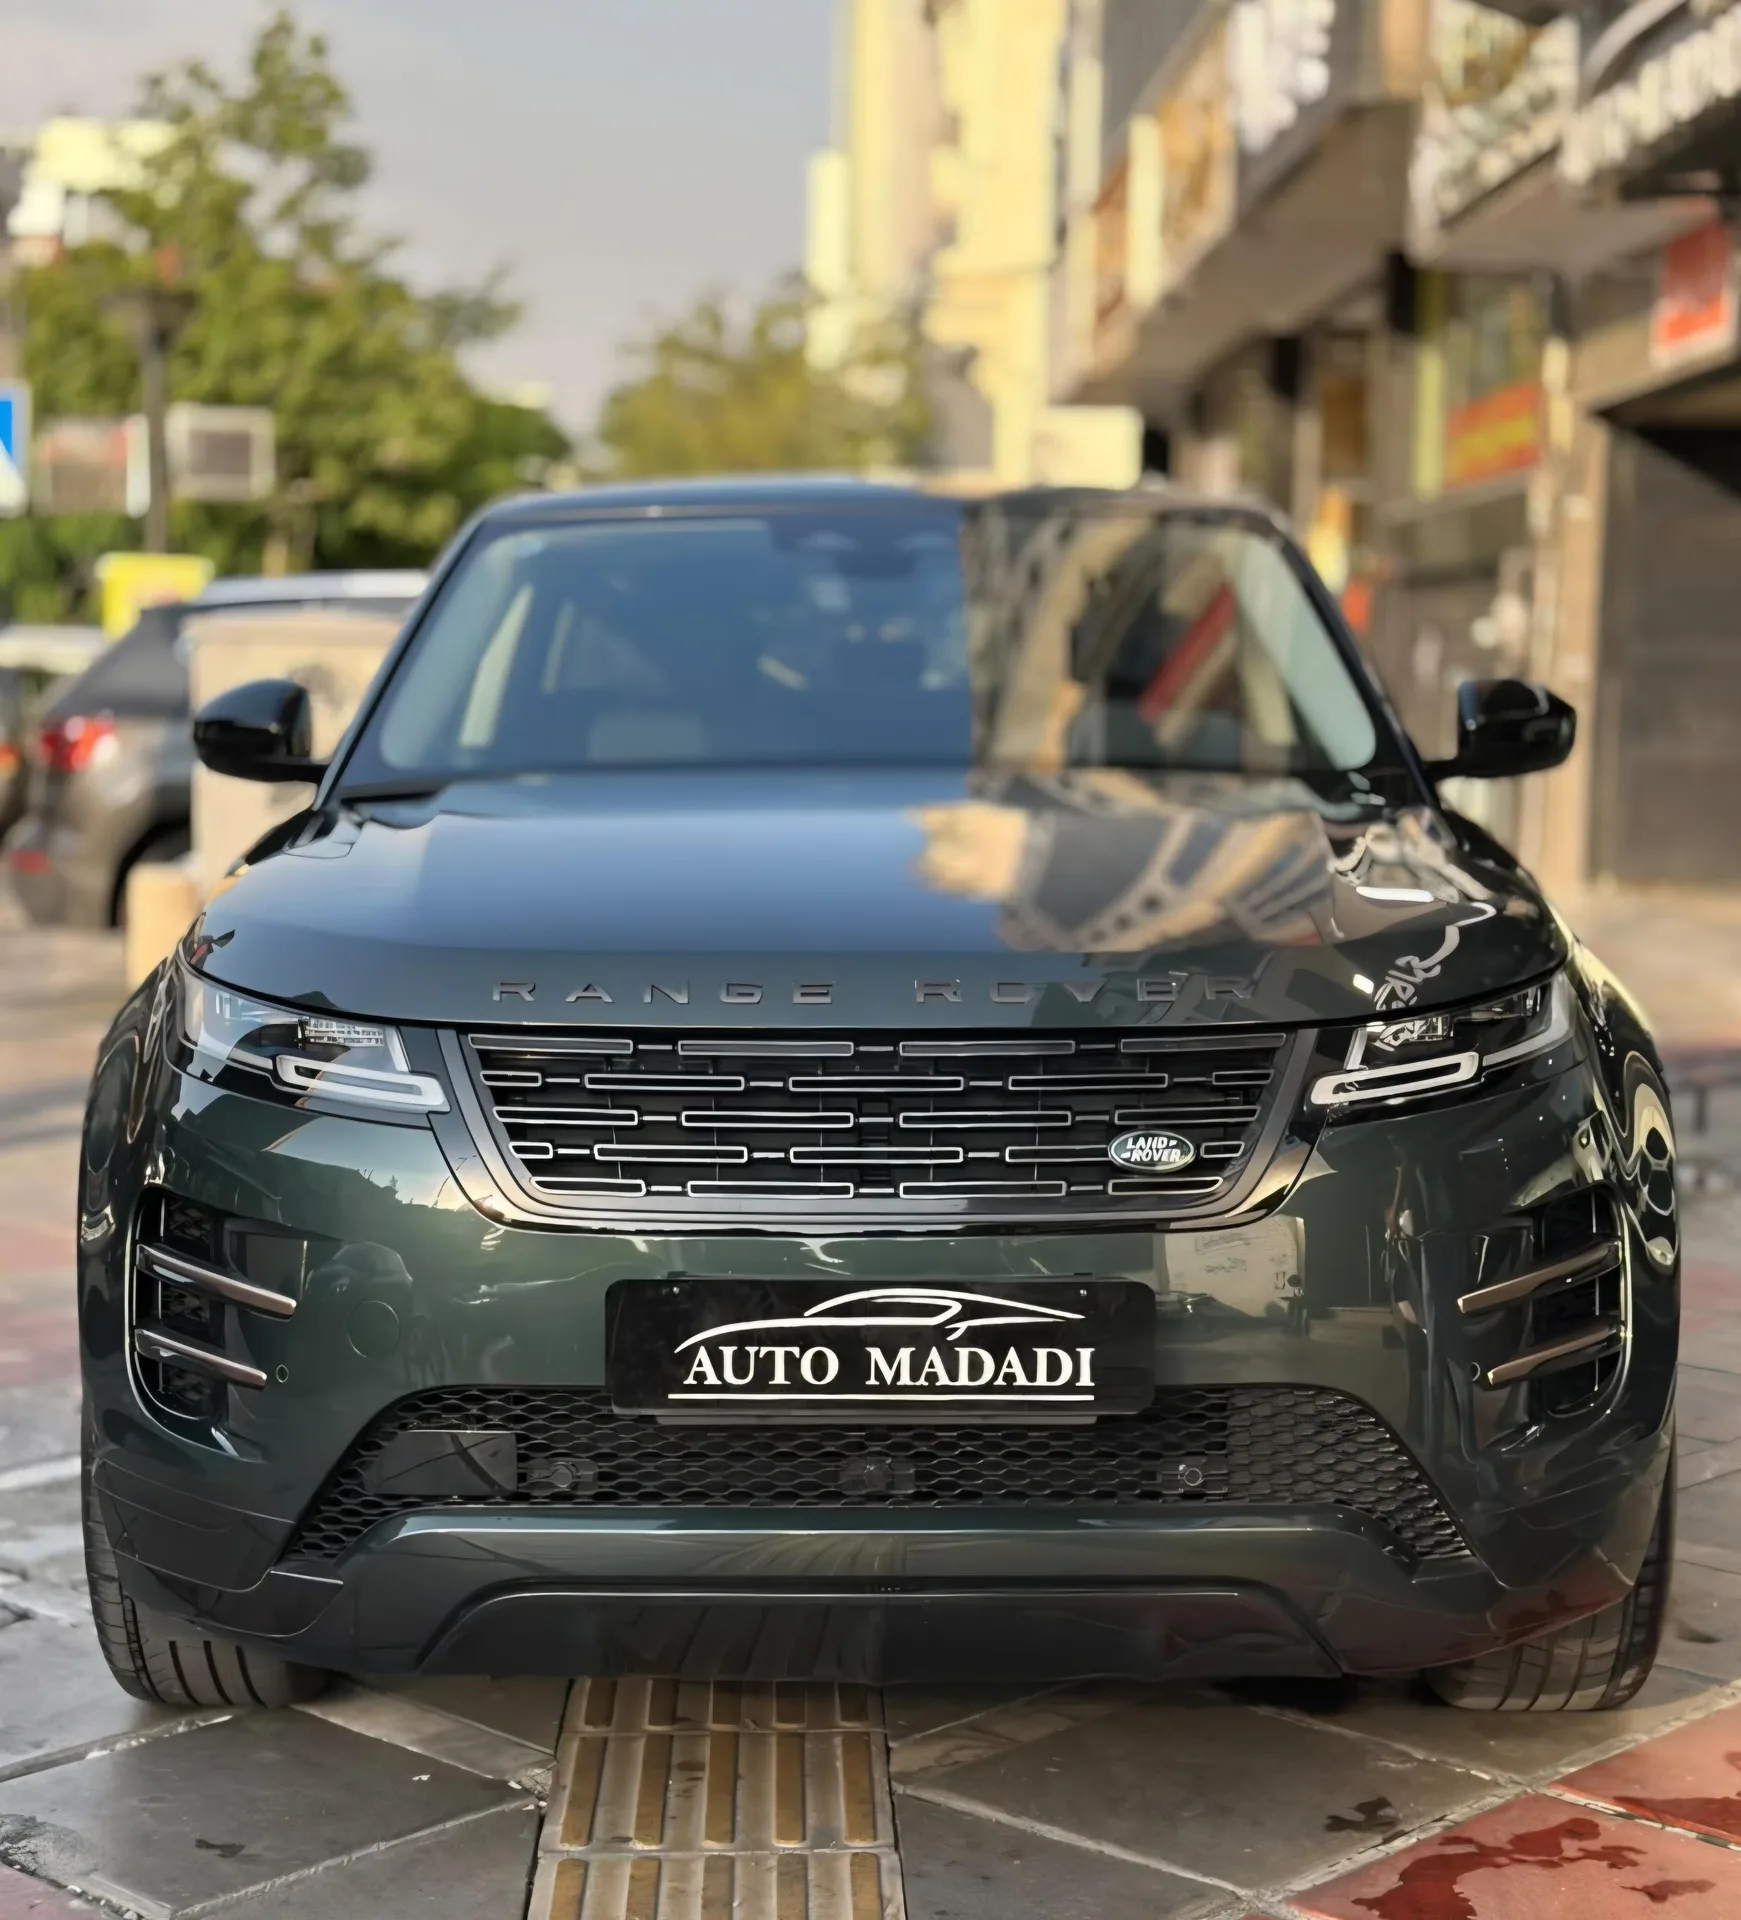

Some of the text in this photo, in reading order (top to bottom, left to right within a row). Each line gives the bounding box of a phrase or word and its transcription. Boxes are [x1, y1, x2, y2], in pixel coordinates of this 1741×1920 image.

[493, 974, 1253, 1005] RANGE ROVER
[1125, 1136, 1168, 1150] LAND
[1130, 1148, 1182, 1163] ROVER
[682, 1345, 1096, 1387] AUTO MADADI
